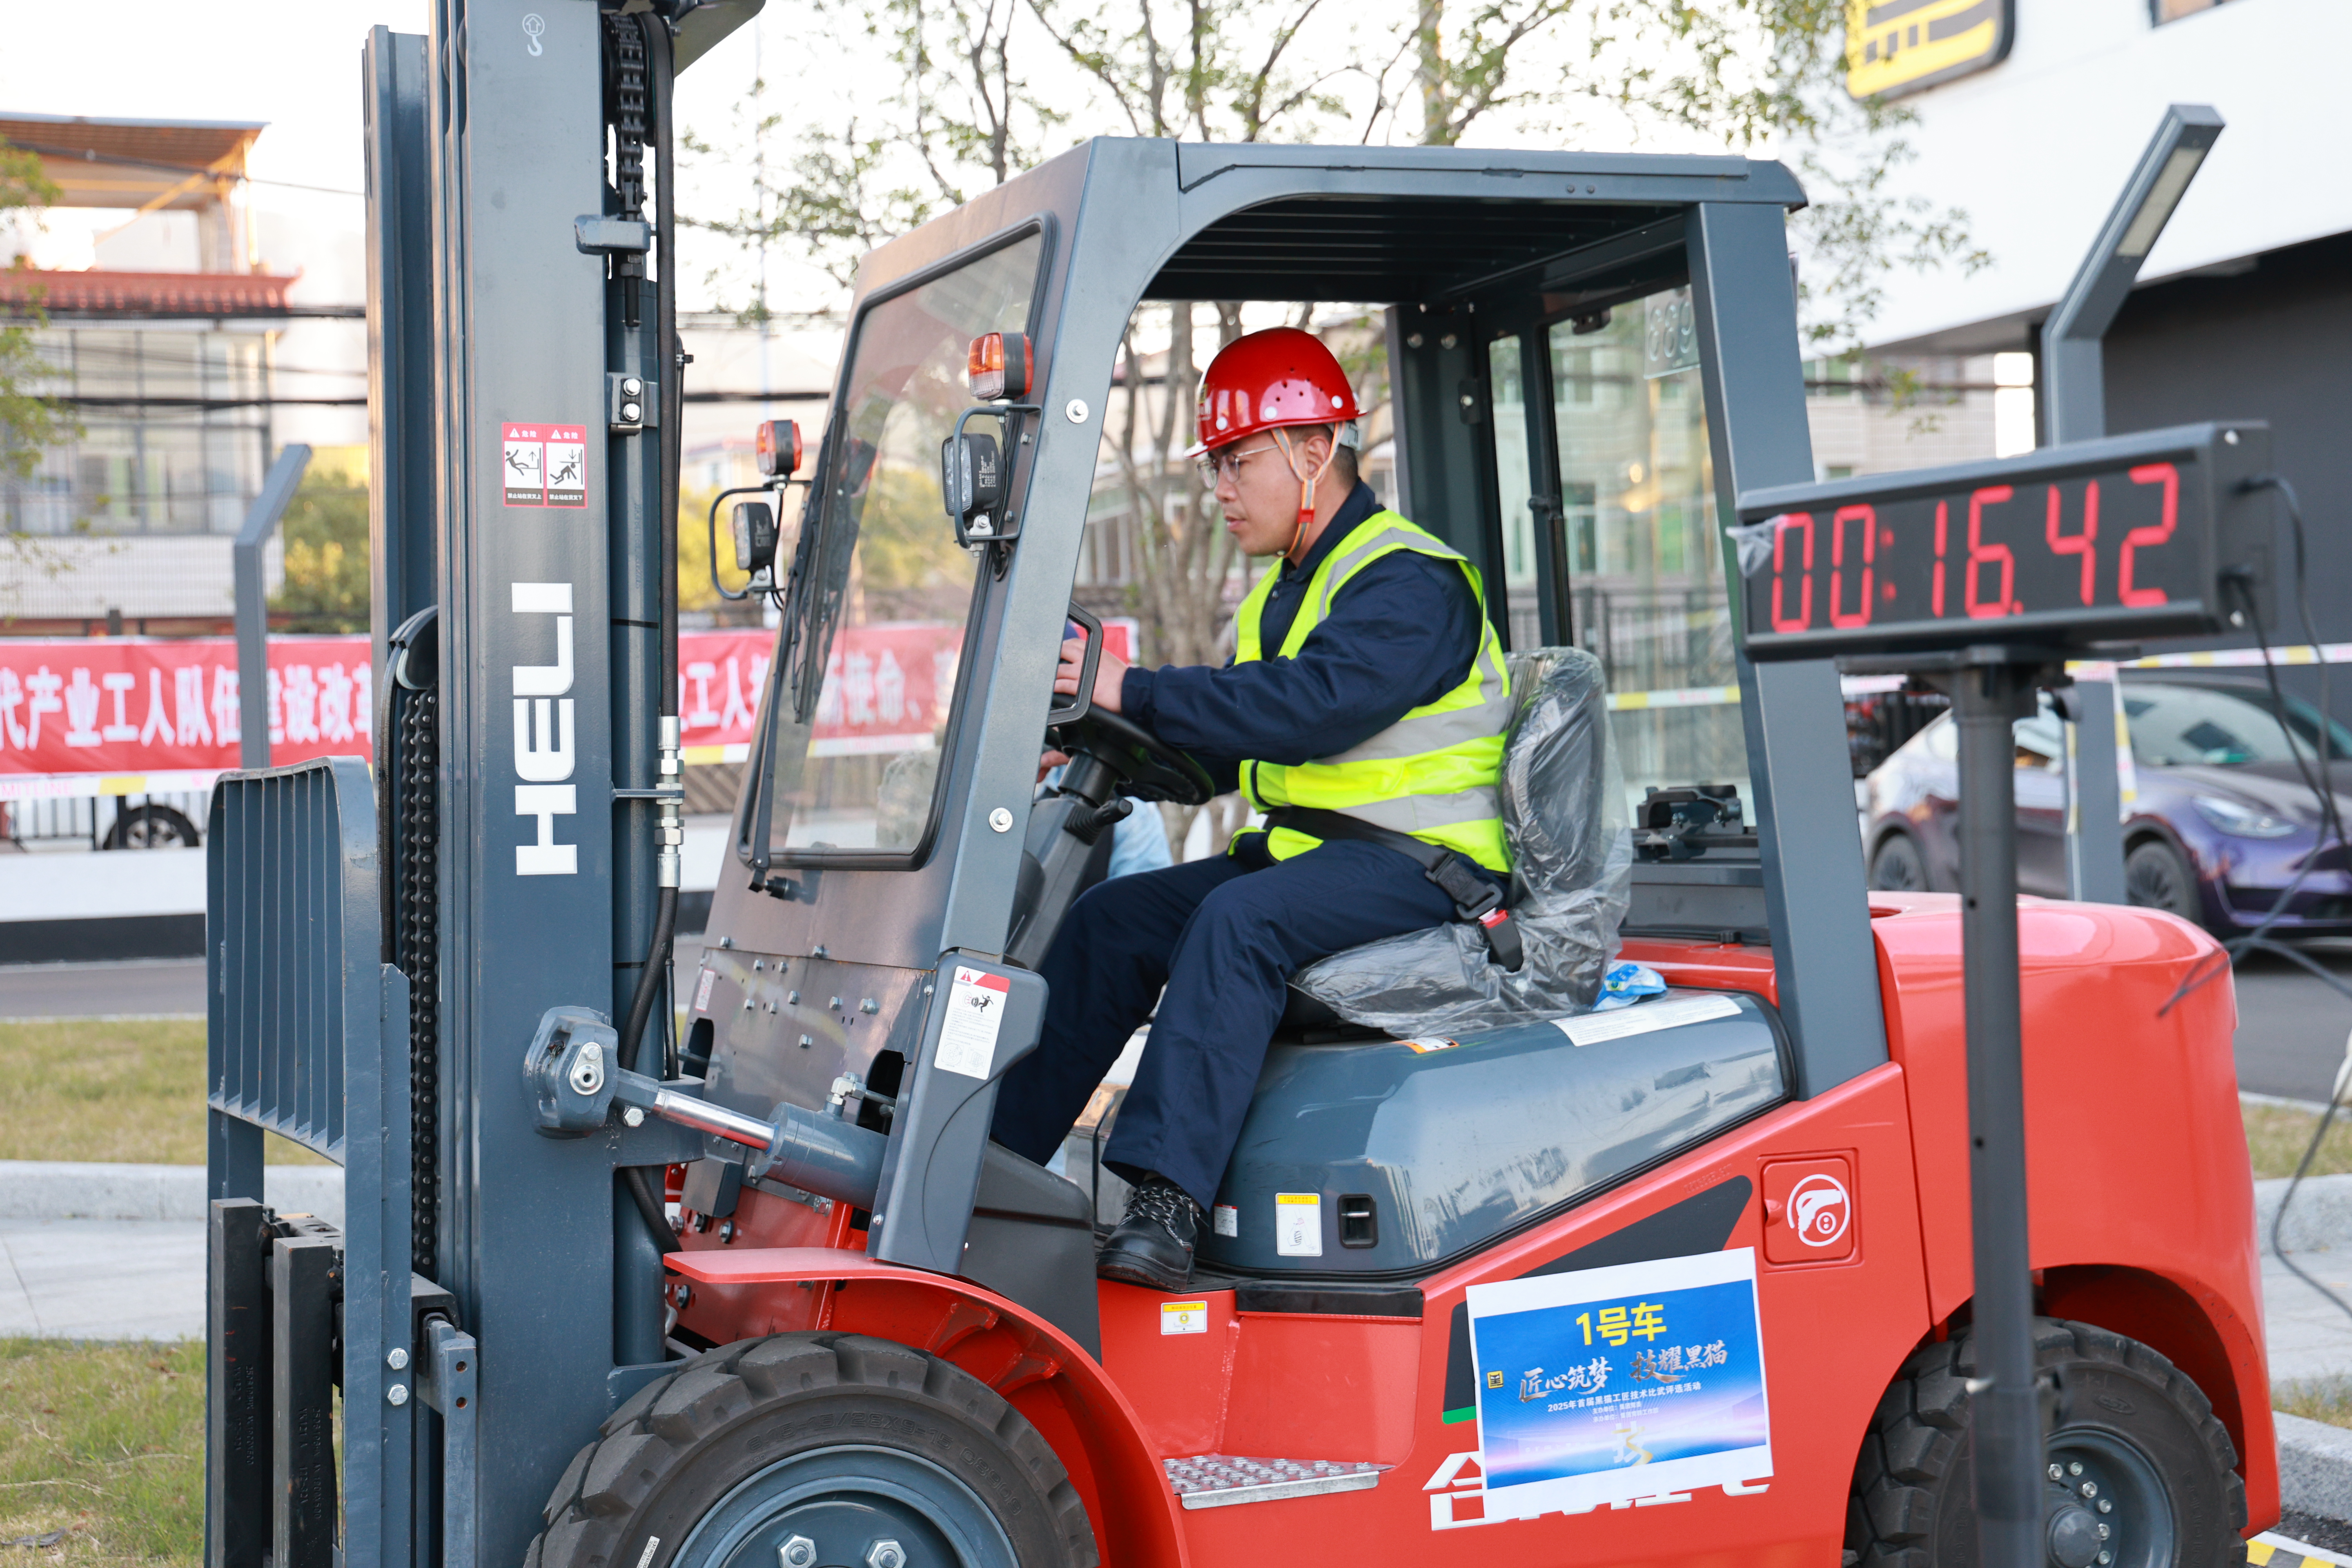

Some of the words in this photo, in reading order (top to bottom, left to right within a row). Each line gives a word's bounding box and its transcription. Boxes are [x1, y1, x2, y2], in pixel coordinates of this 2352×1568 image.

[521, 430, 537, 438] 危险
[563, 431, 578, 439] 危险
[511, 583, 577, 876] HELI
[1575, 1302, 1667, 1347] 1号车
[1519, 1356, 1613, 1403] 匠心筑梦
[1629, 1339, 1728, 1383] 技耀黑猫
[1547, 1381, 1701, 1412] 2025年首届黑猫工匠技术比武评选活动
